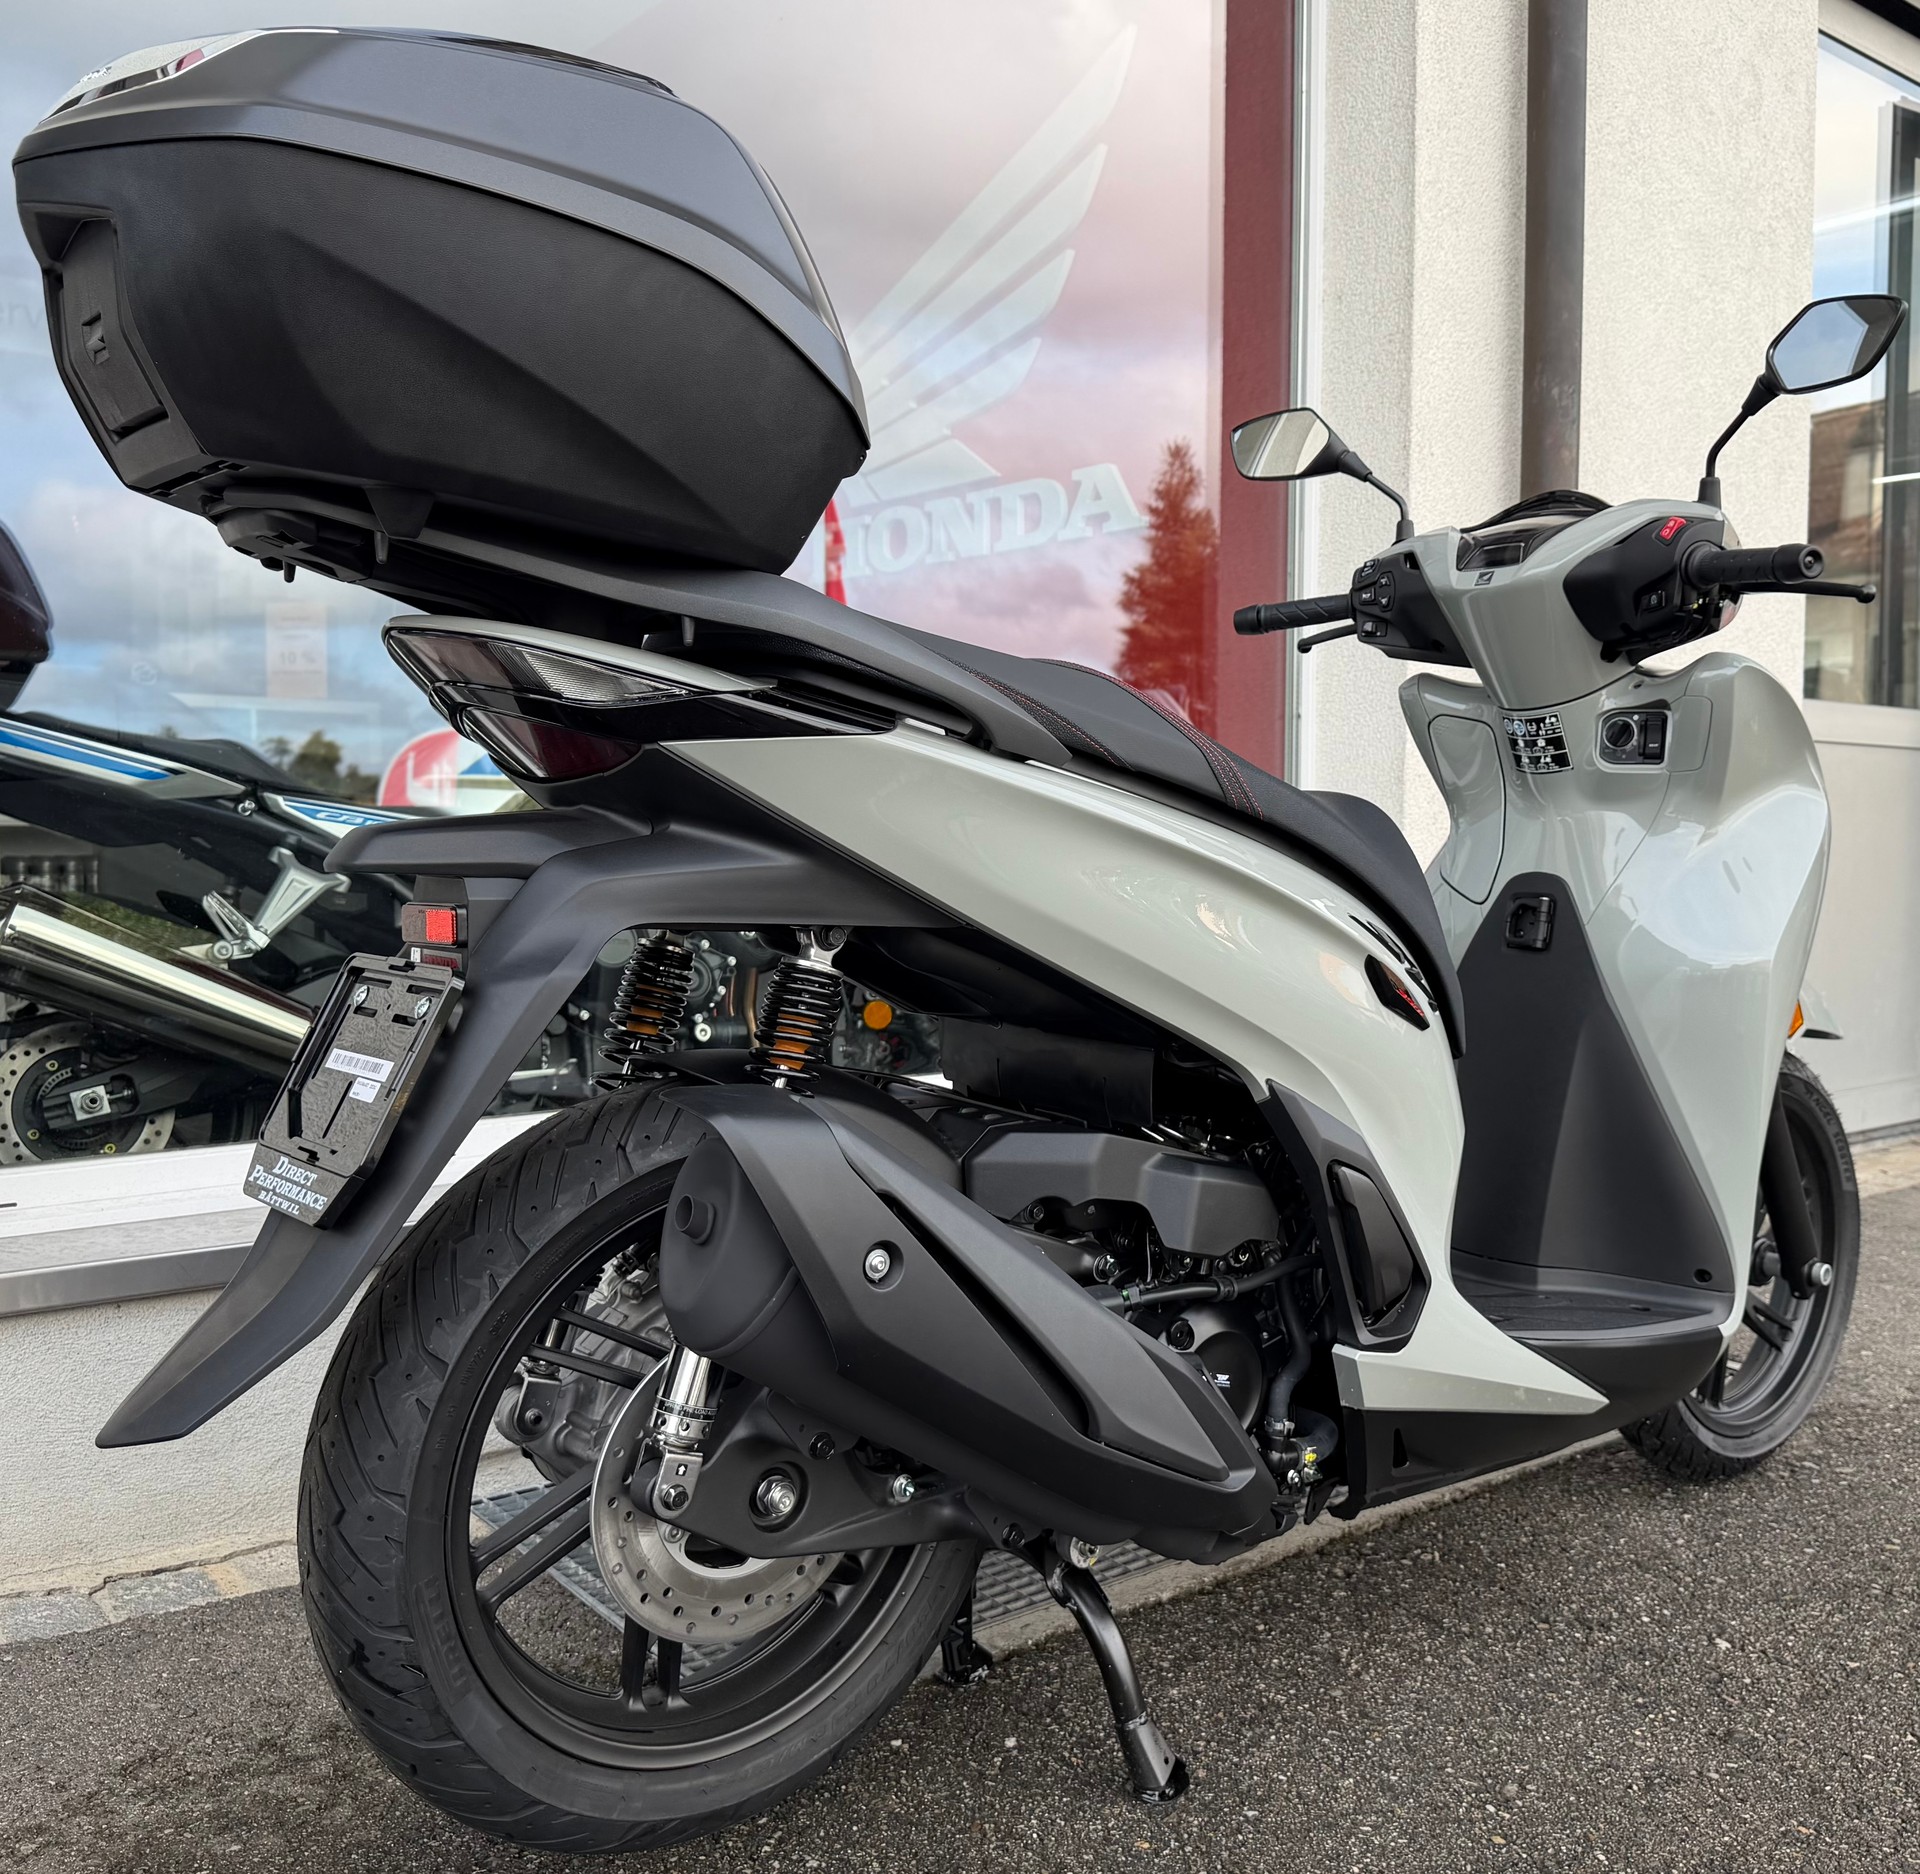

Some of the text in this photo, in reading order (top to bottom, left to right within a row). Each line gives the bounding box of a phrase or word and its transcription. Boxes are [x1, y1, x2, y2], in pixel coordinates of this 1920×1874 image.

[810, 463, 1150, 581] HONDA
[248, 1164, 328, 1211] PERFORMANCE
[272, 1155, 318, 1187] DIRECT
